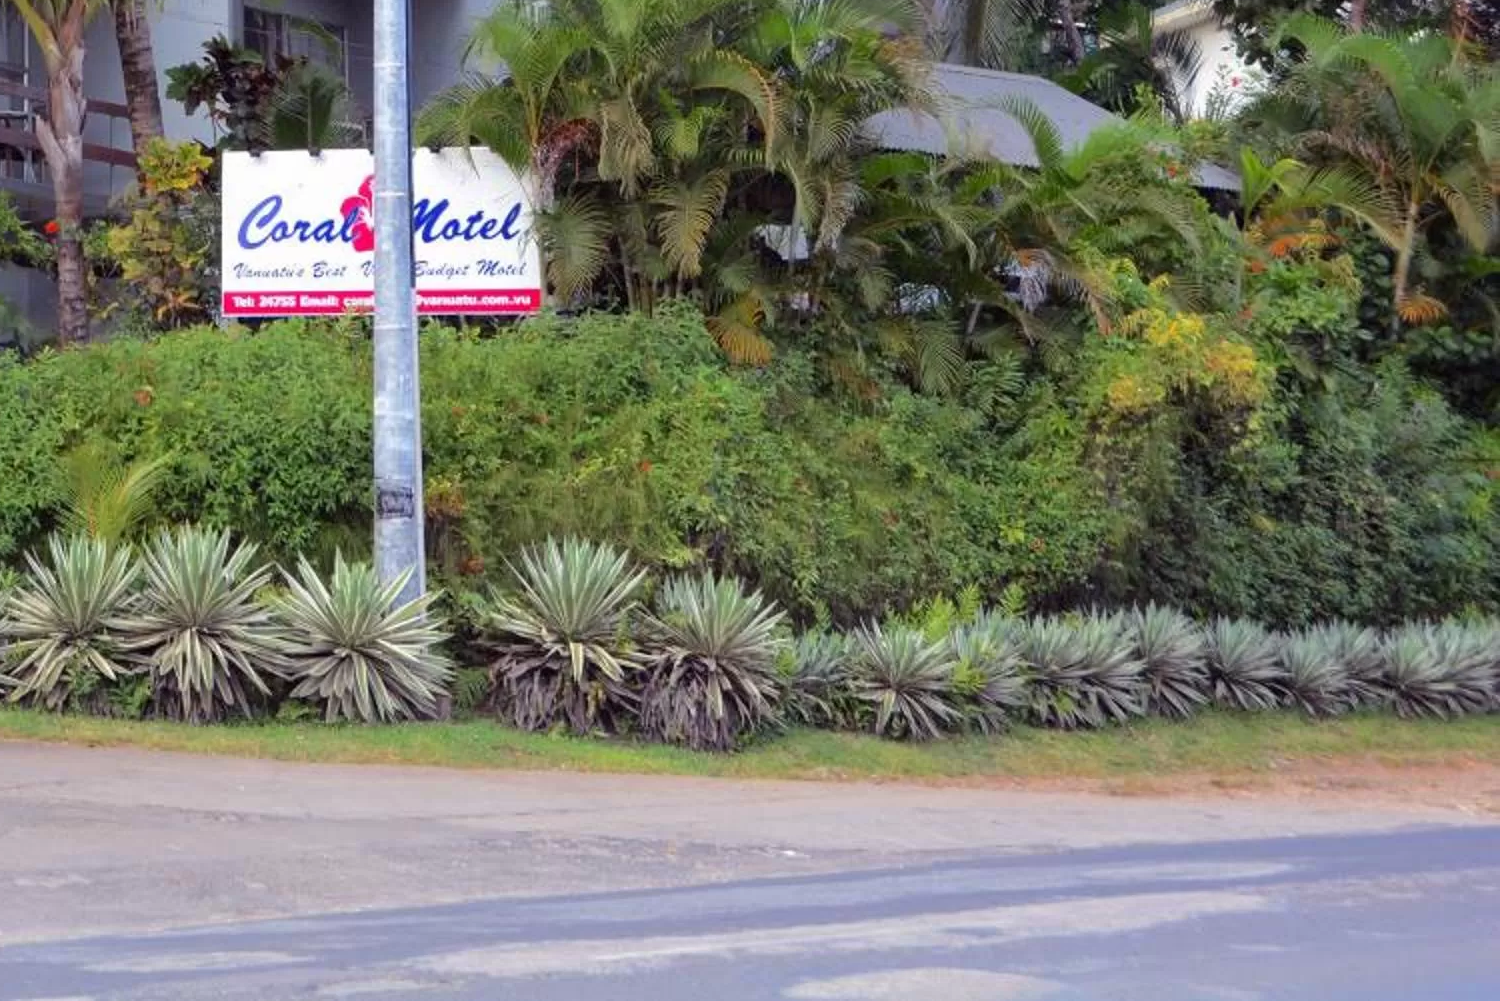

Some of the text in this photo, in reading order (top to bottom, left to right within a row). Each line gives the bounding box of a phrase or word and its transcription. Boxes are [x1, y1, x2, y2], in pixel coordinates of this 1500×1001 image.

[237, 195, 522, 249] Coral Motel
[312, 260, 348, 279] Best
[476, 259, 527, 277] Motel
